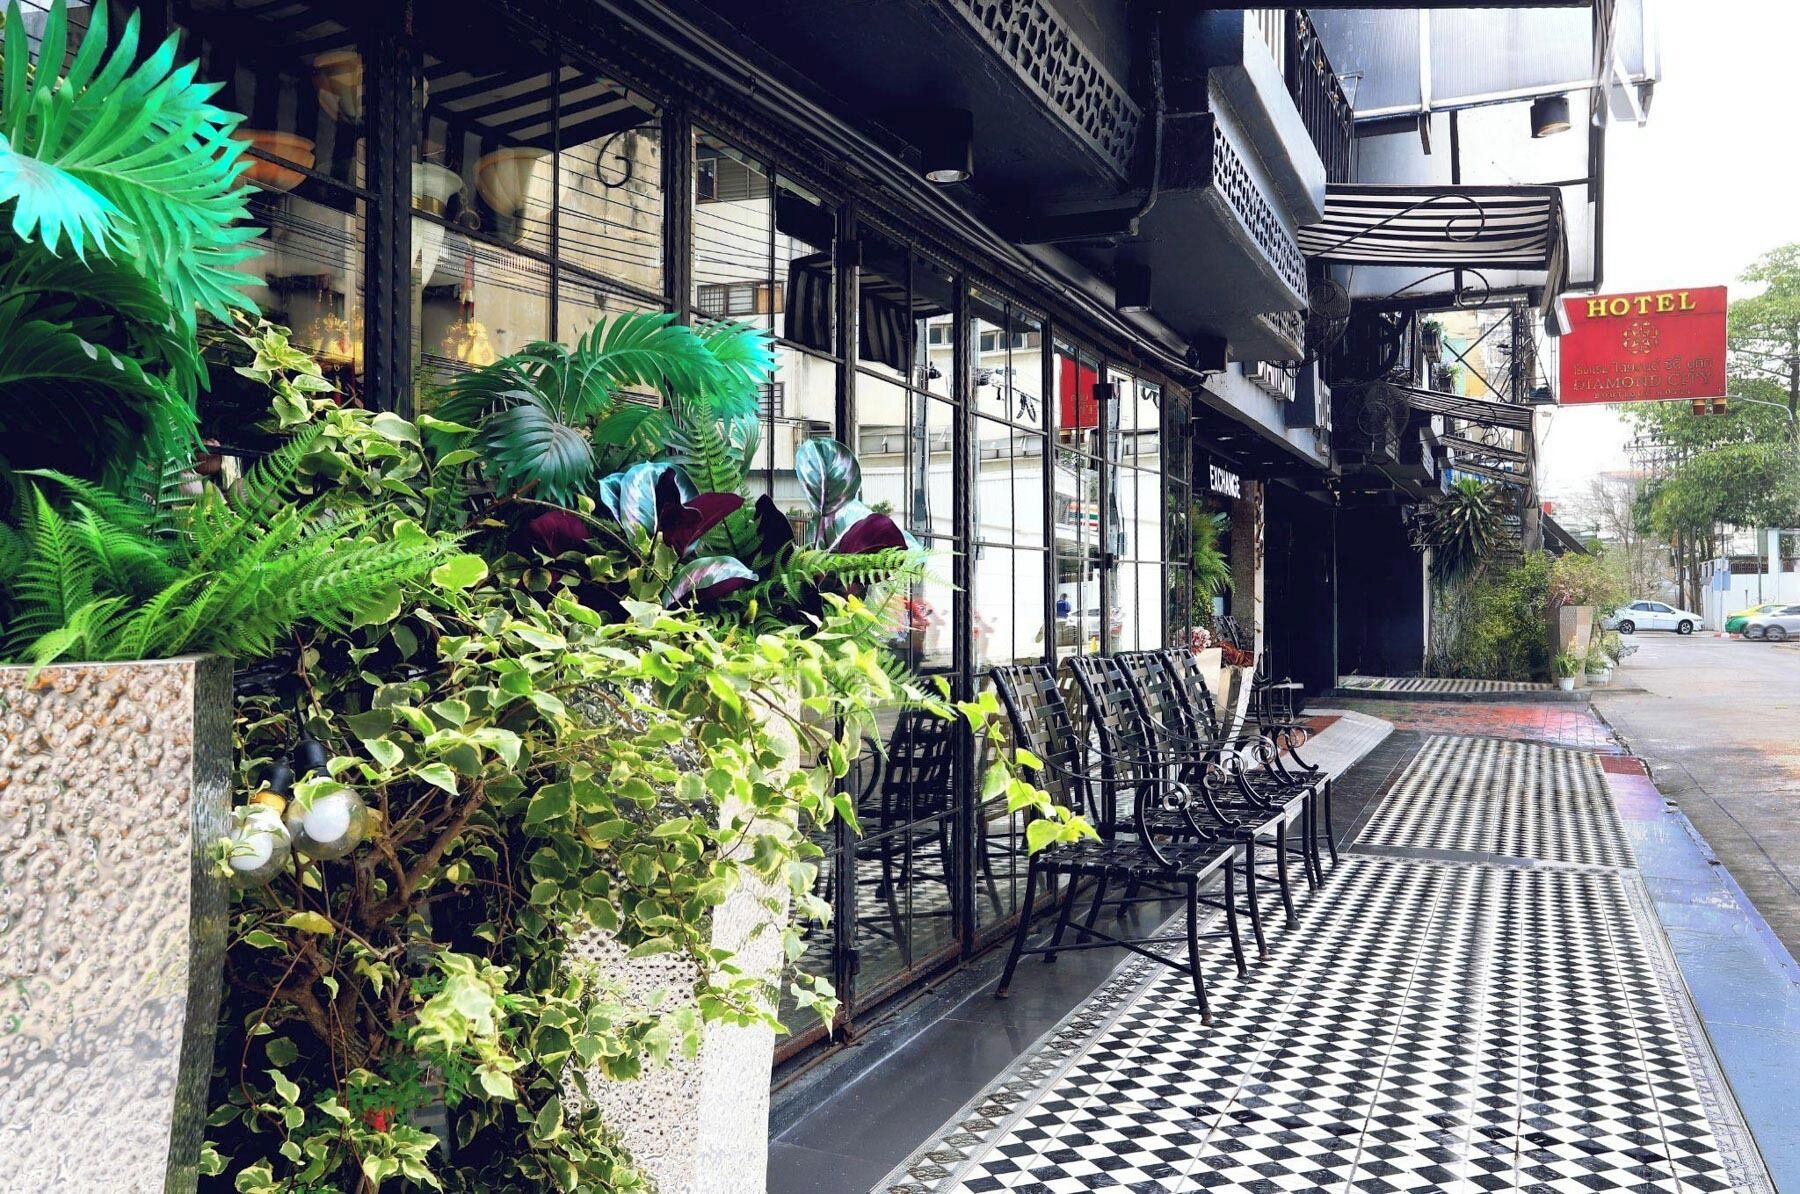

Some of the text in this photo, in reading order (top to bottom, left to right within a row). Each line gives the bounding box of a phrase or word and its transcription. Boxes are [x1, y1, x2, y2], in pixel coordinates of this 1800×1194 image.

[1586, 292, 1696, 318] HOTEL
[1573, 370, 1711, 392] DIAMOND CITY
[1209, 464, 1241, 499] EXCHANGE
